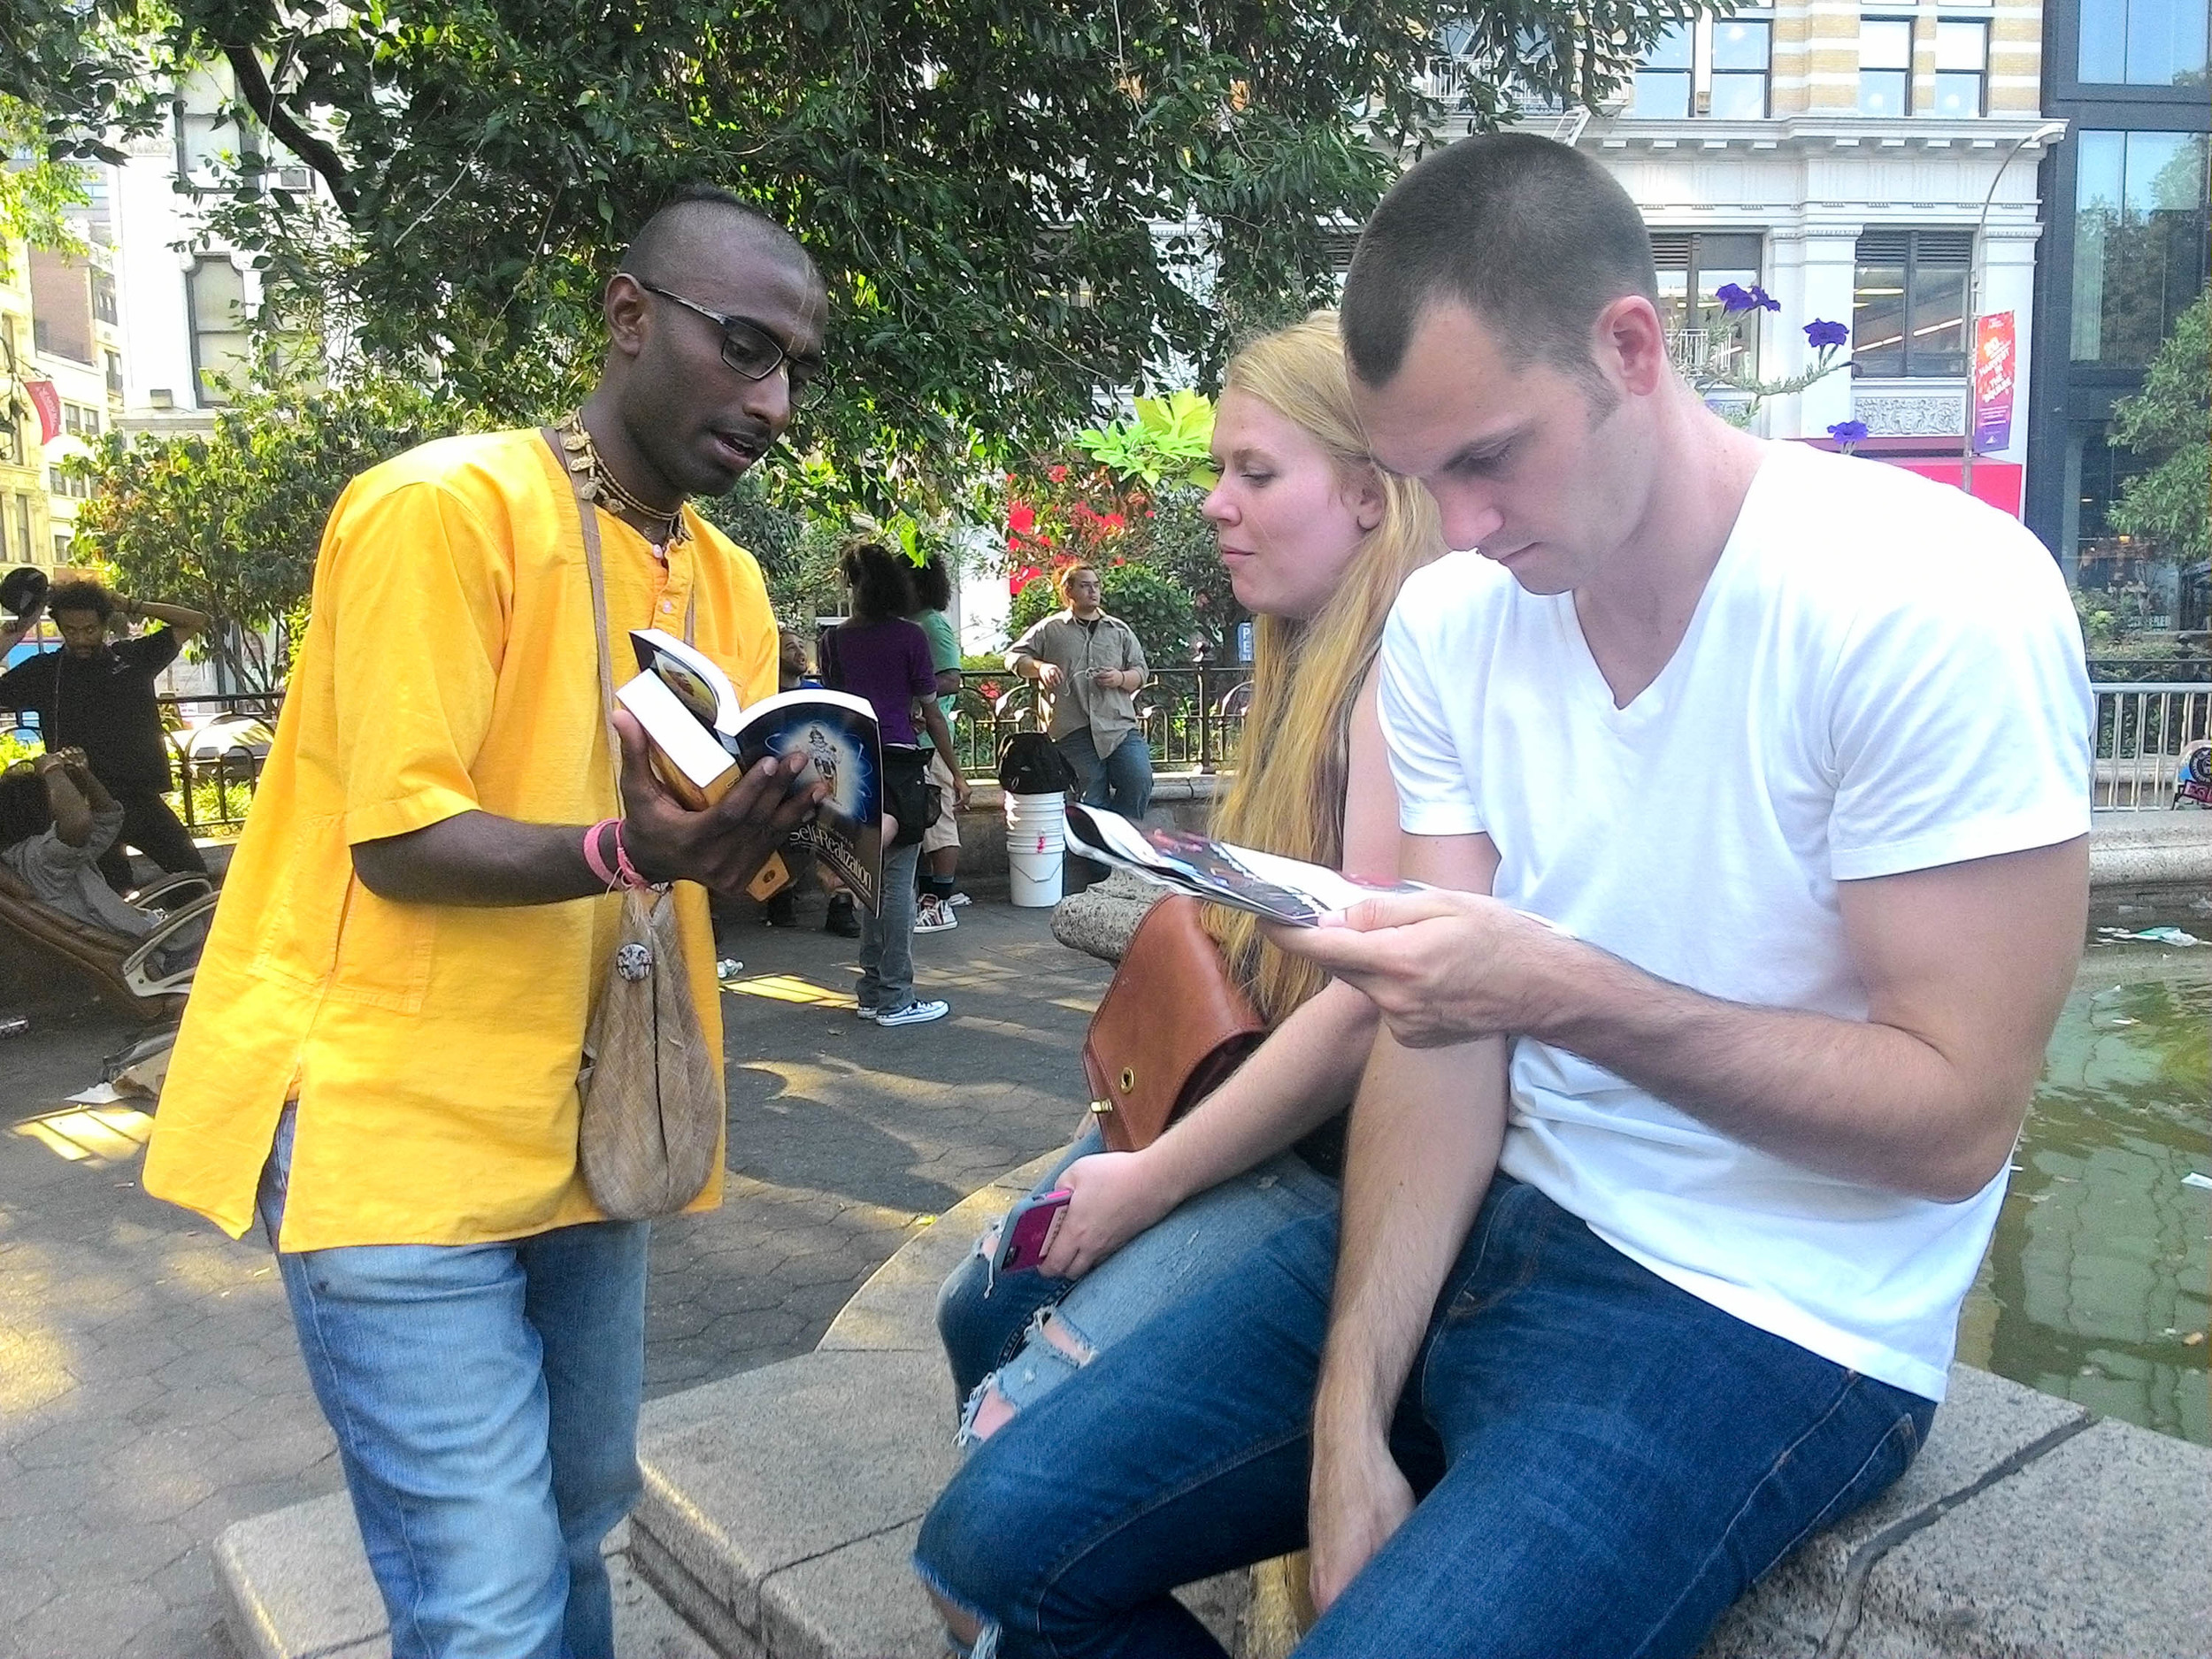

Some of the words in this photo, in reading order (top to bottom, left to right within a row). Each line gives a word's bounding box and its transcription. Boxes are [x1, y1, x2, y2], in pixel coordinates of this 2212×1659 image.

[1978, 347, 2010, 377] HARVEST
[1982, 376, 2013, 403] SQUARE
[1989, 373, 2005, 389] THE
